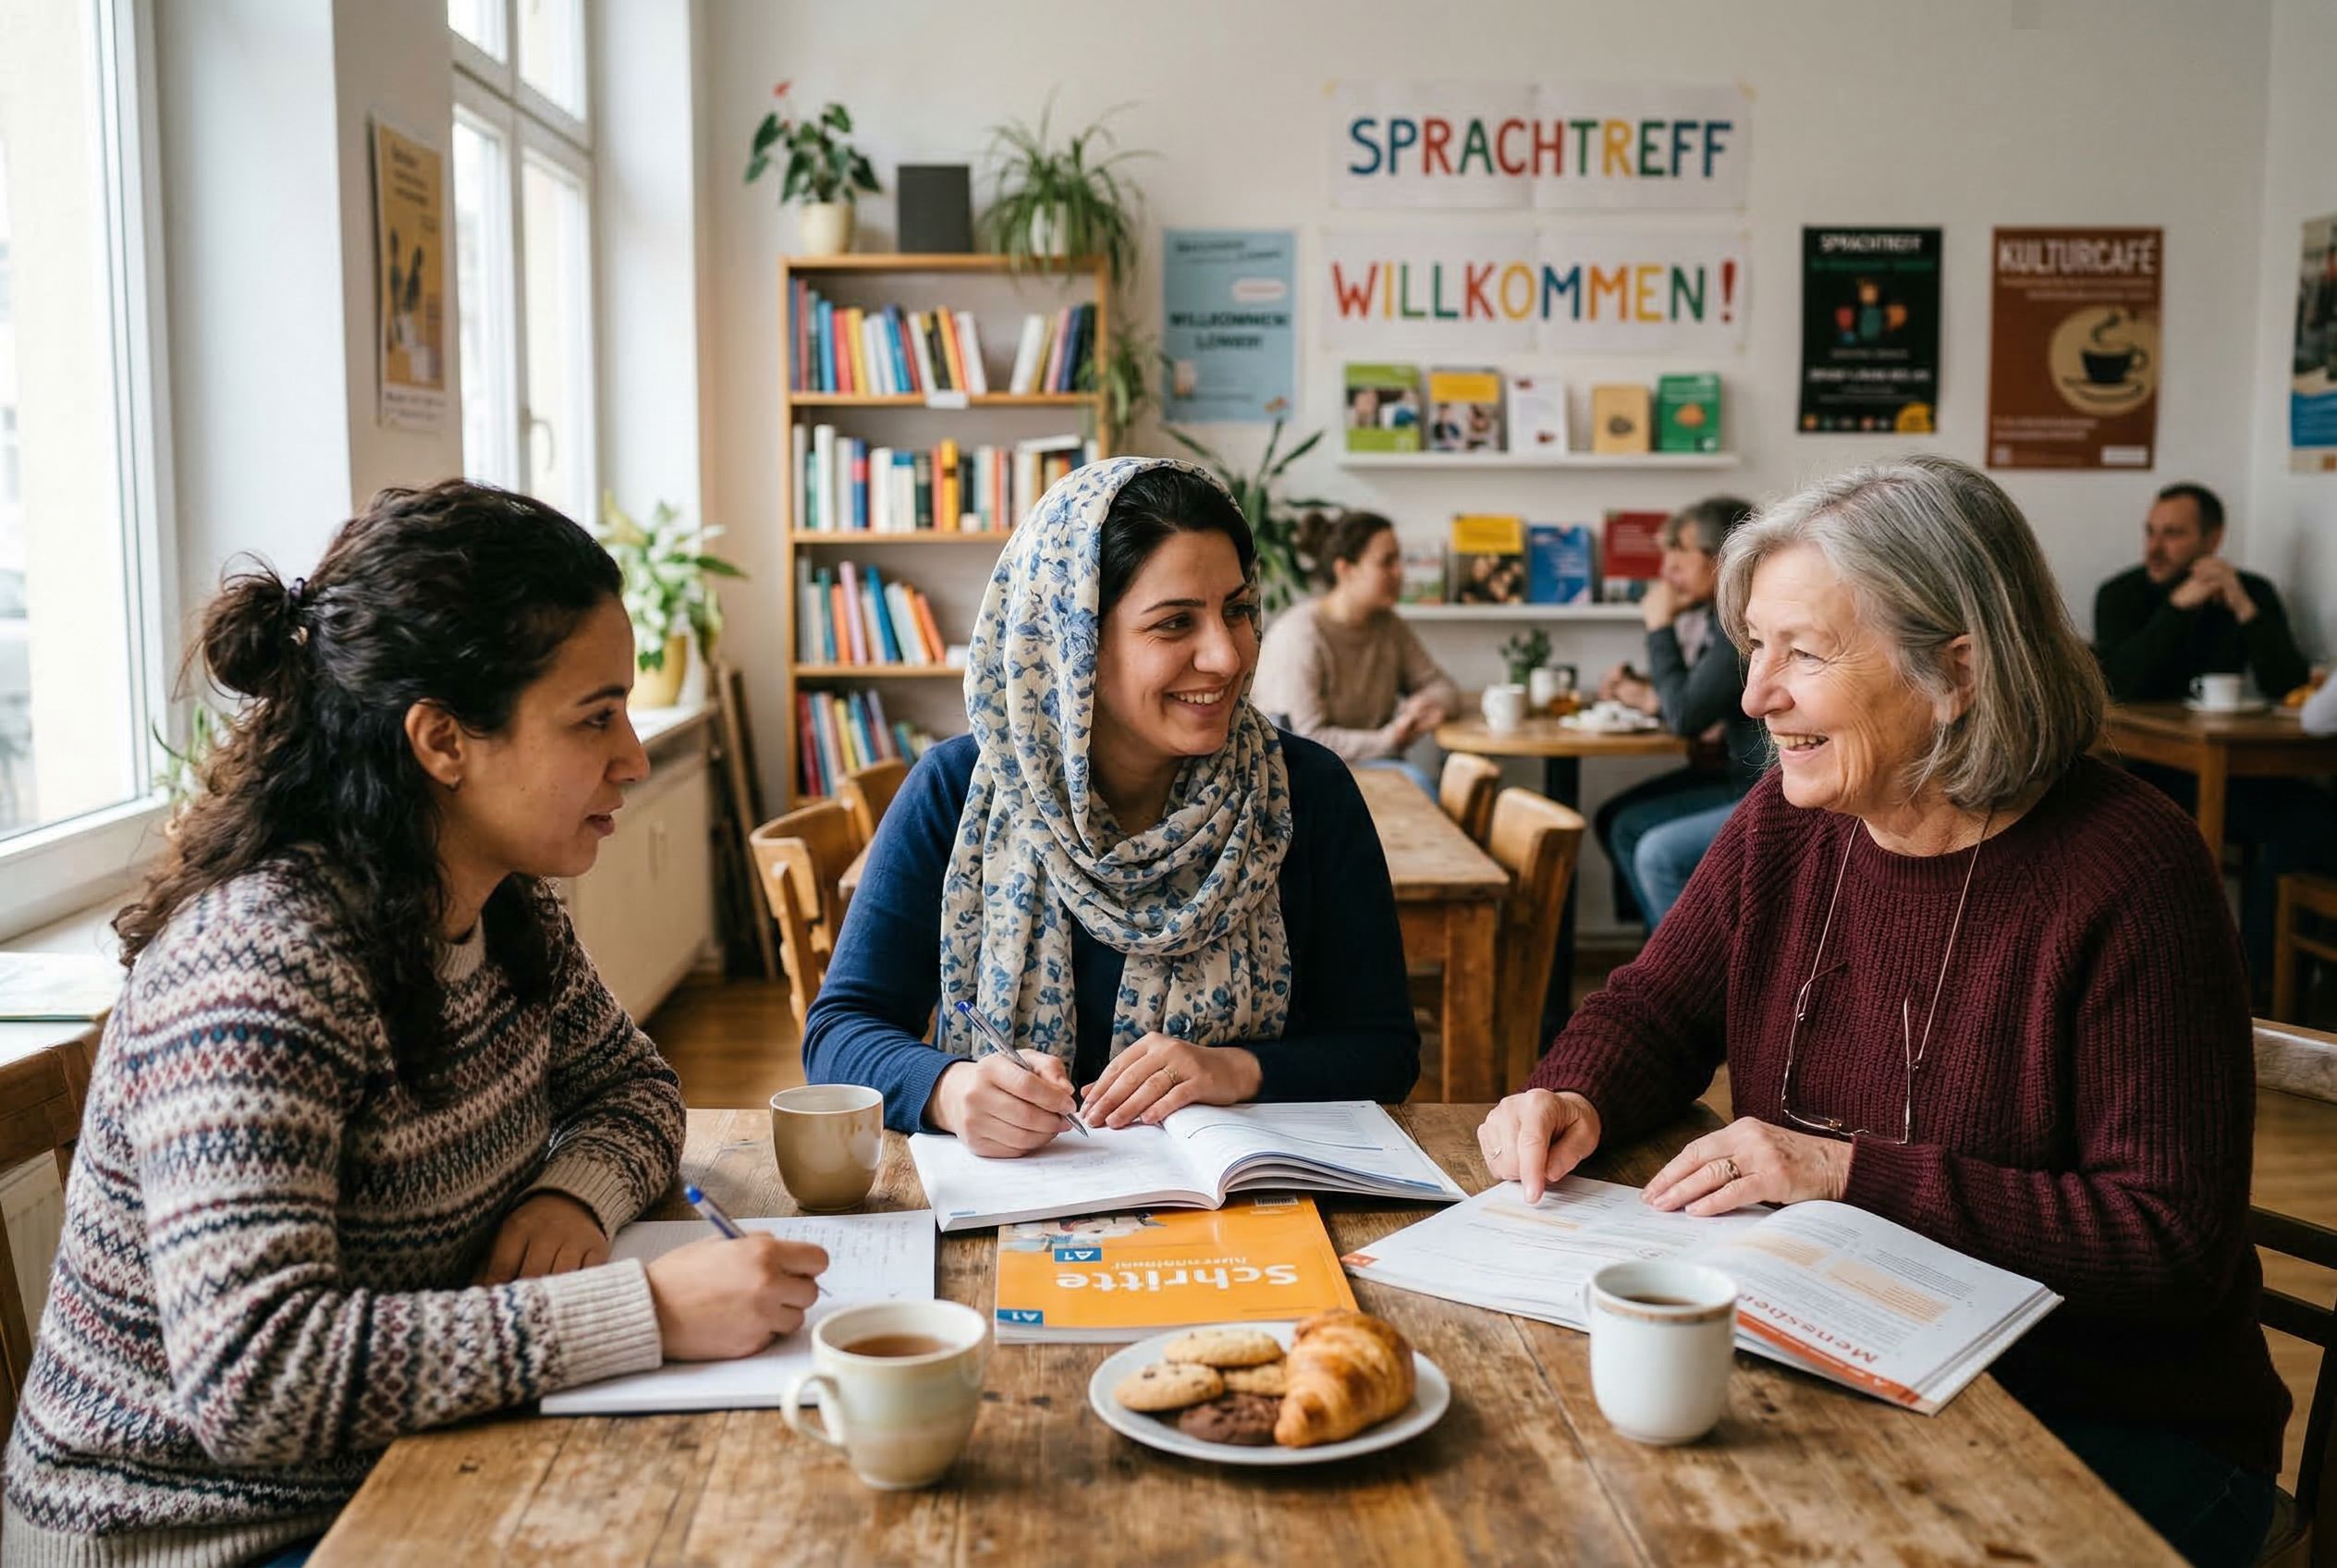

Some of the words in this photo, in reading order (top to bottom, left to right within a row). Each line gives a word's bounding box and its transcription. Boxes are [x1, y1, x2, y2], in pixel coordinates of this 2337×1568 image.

[1349, 117, 1733, 178] SPRACHTREFF
[1998, 235, 2157, 275] KULTURCAFÉ
[1331, 260, 1737, 324] WILLKOMMEN!
[1064, 1250, 1095, 1261] A1
[1056, 1264, 1299, 1292] Schritte
